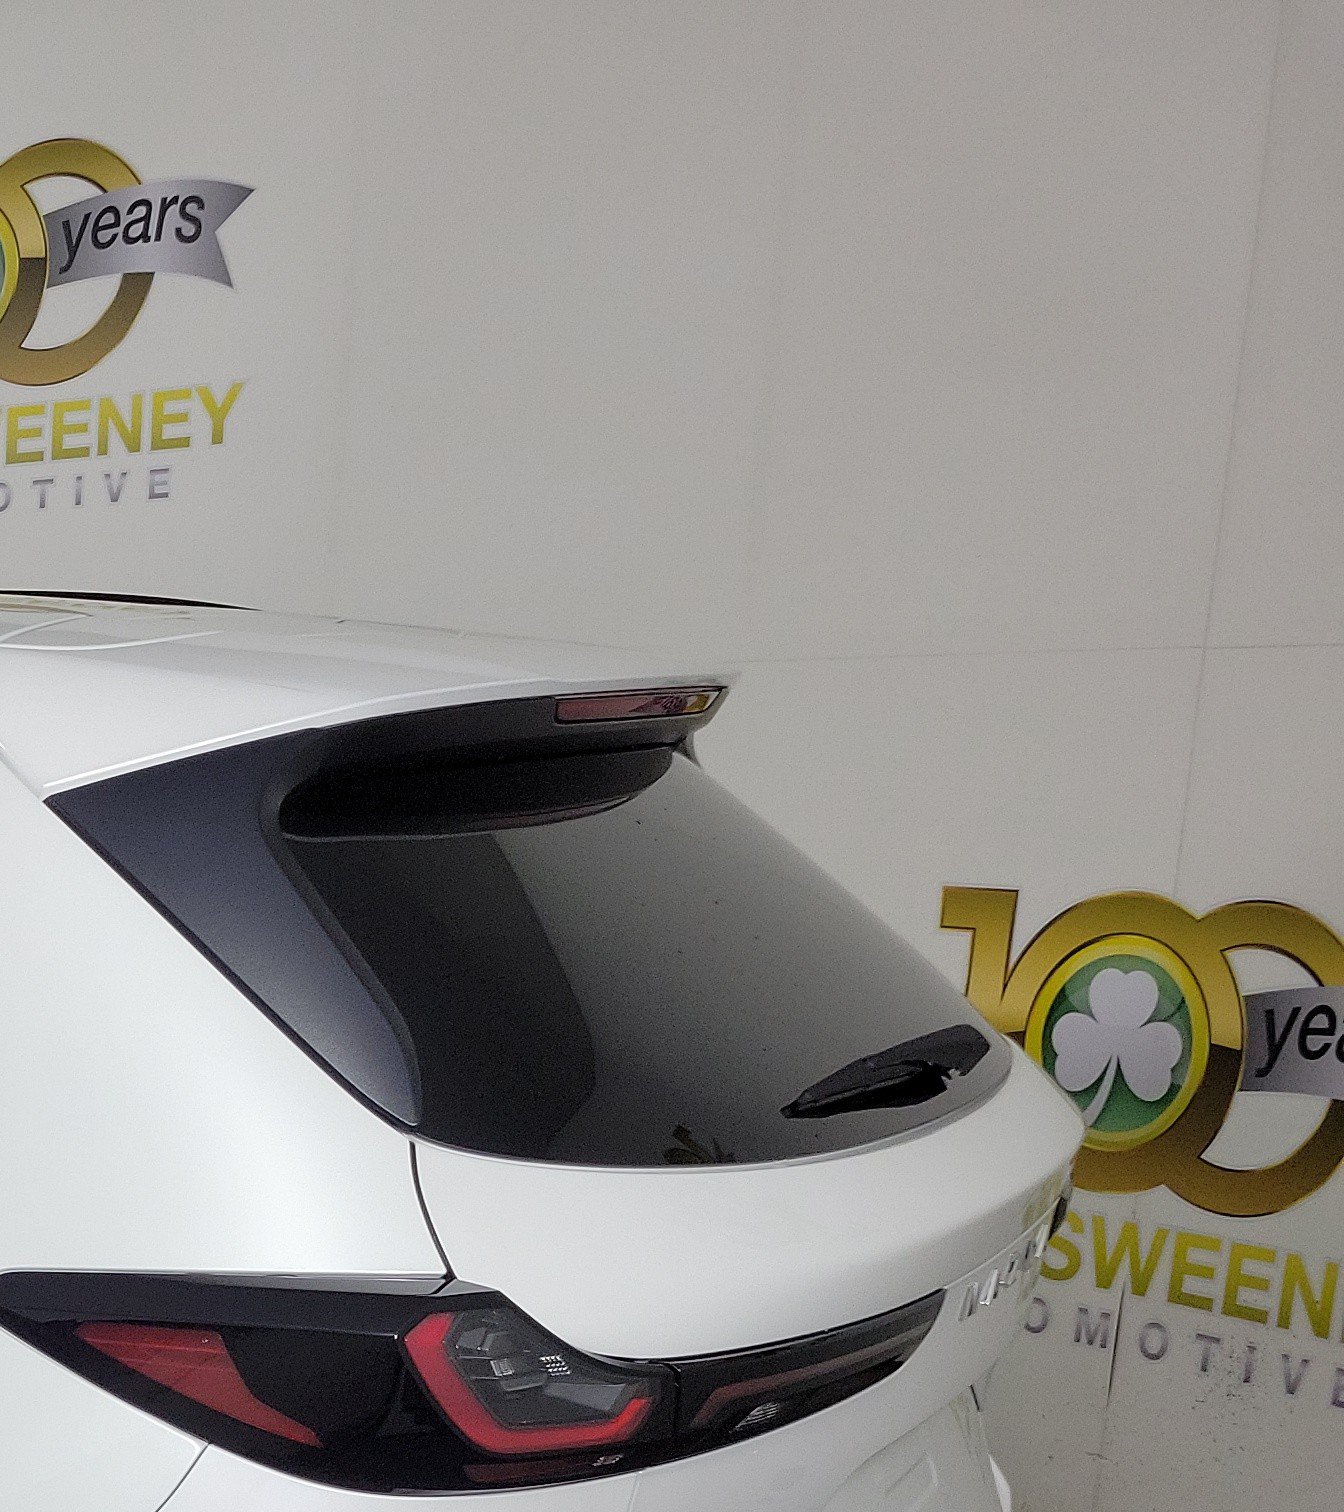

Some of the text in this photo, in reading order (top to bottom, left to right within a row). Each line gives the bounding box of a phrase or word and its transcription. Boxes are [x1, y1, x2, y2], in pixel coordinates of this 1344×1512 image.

[59, 193, 206, 275] years
[1255, 1004, 1344, 1078] ye
[1040, 1211, 1344, 1344] SWEEN
